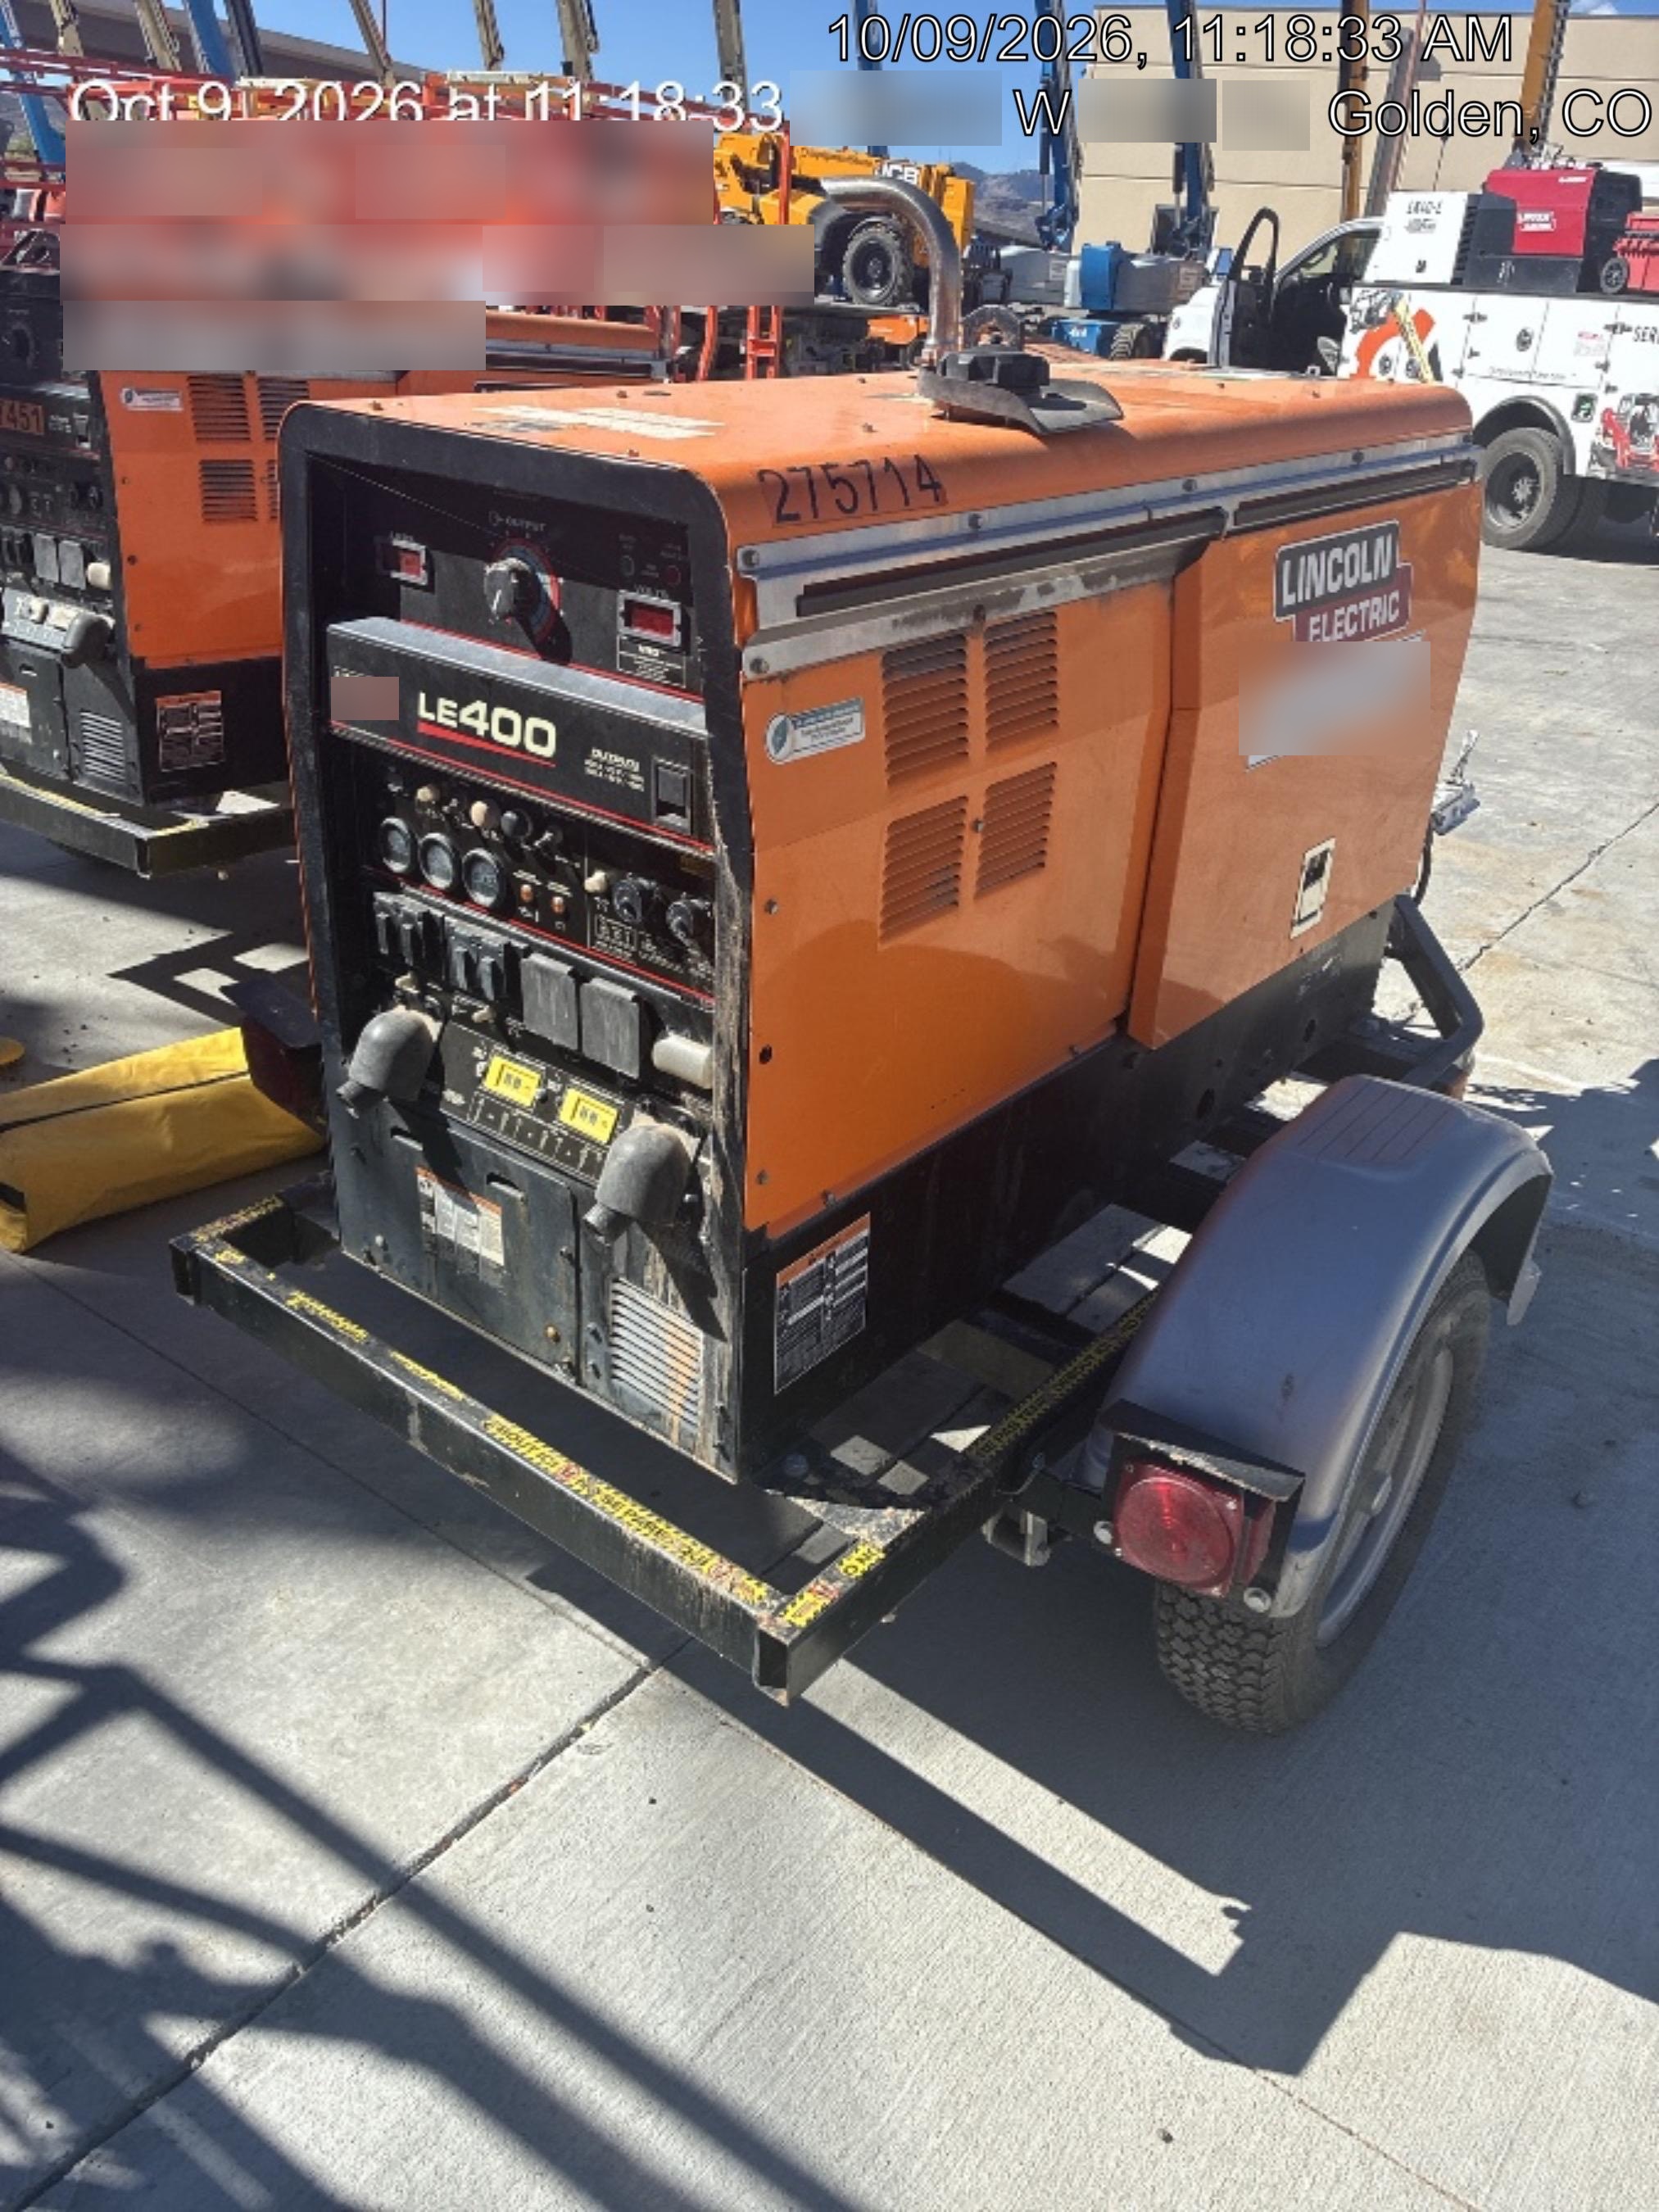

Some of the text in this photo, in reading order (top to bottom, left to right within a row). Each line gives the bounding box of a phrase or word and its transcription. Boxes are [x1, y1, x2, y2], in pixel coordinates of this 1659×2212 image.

[758, 454, 943, 524] 275714
[1281, 533, 1394, 608] LINCOLN
[1308, 590, 1401, 642] ELECTRIC
[417, 691, 558, 758] LE400
